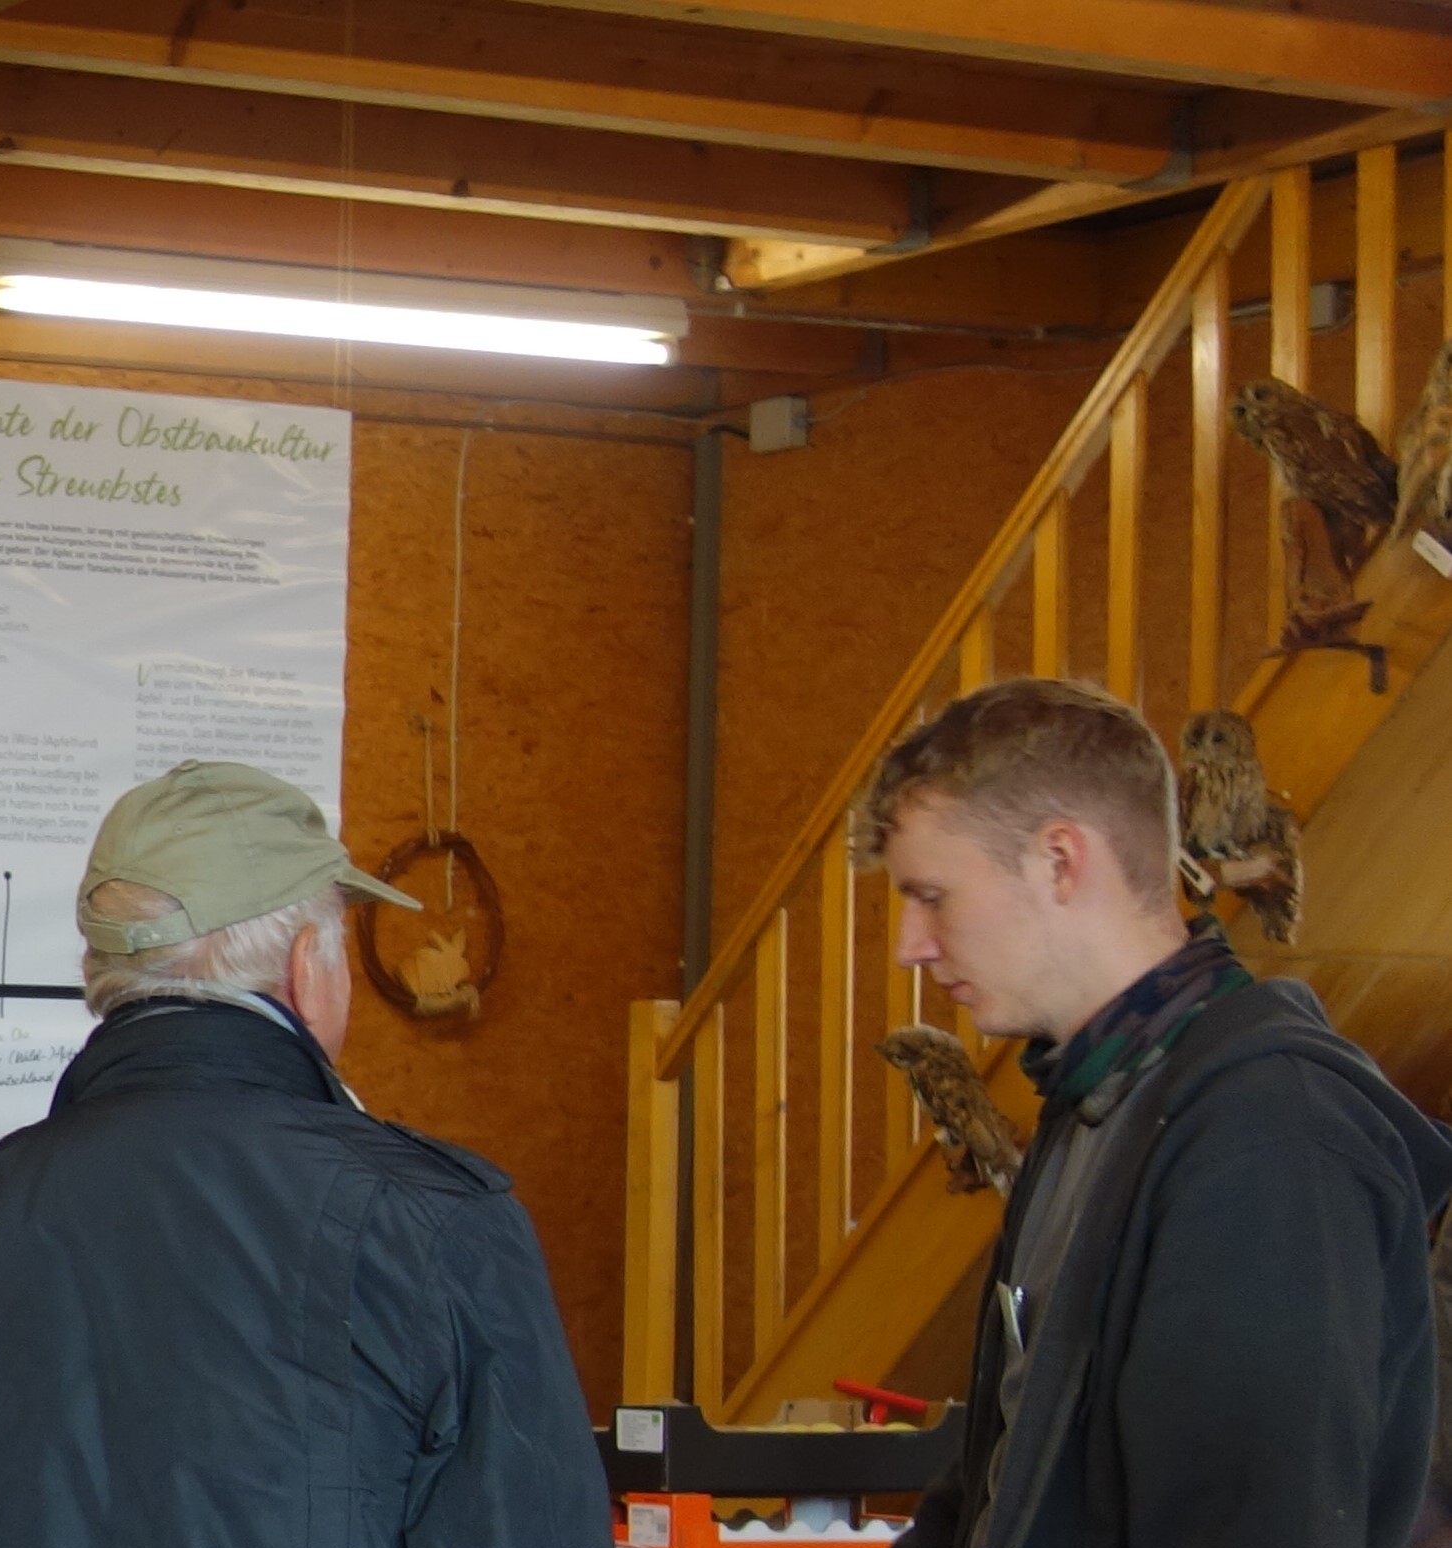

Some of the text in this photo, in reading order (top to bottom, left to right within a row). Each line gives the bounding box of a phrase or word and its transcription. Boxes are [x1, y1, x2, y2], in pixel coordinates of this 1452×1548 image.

[49, 408, 98, 442] der
[116, 404, 340, 462] Obstbaukultur
[16, 453, 182, 507] Streuobstes
